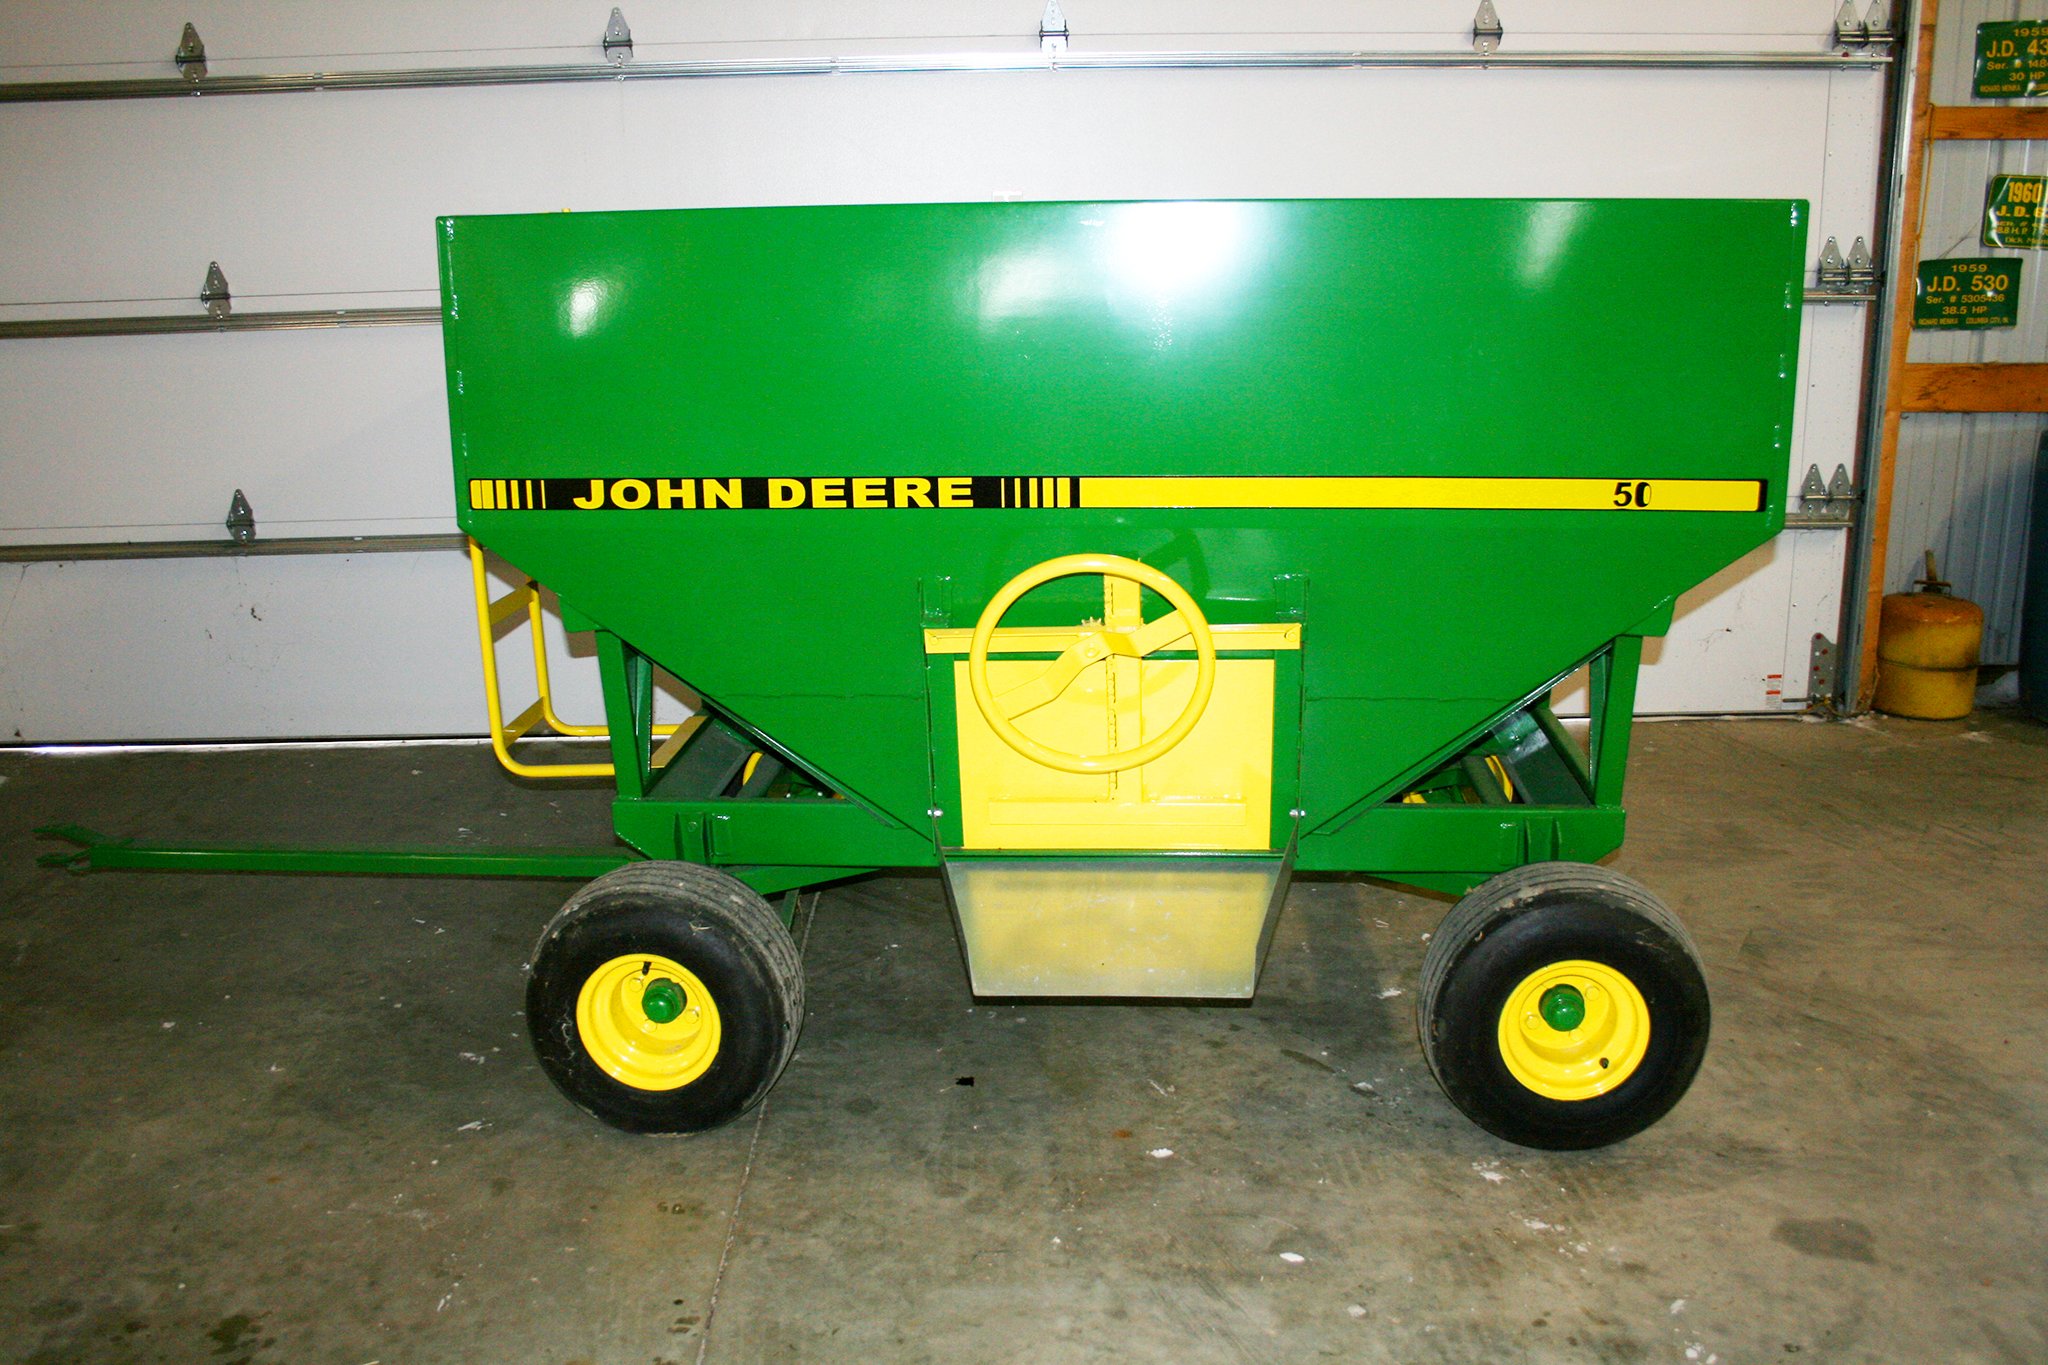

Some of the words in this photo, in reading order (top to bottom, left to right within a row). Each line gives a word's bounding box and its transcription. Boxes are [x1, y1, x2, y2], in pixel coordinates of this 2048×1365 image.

[1986, 40, 2018, 58] J.D.
[2027, 59, 2048, 68] 148
[2009, 72, 2025, 81] 30
[2029, 71, 2046, 80] HP
[2008, 181, 2042, 203] 1960
[1952, 264, 1988, 273] 1959
[1927, 275, 1961, 292] J.D.
[1971, 274, 2009, 291] 530
[1926, 295, 1945, 304] Ser.
[1942, 305, 1967, 315] 38.5
[1971, 305, 1988, 314] HP
[573, 478, 743, 509] JOHN
[768, 477, 974, 508] DEERE
[1613, 482, 1652, 507] 50
